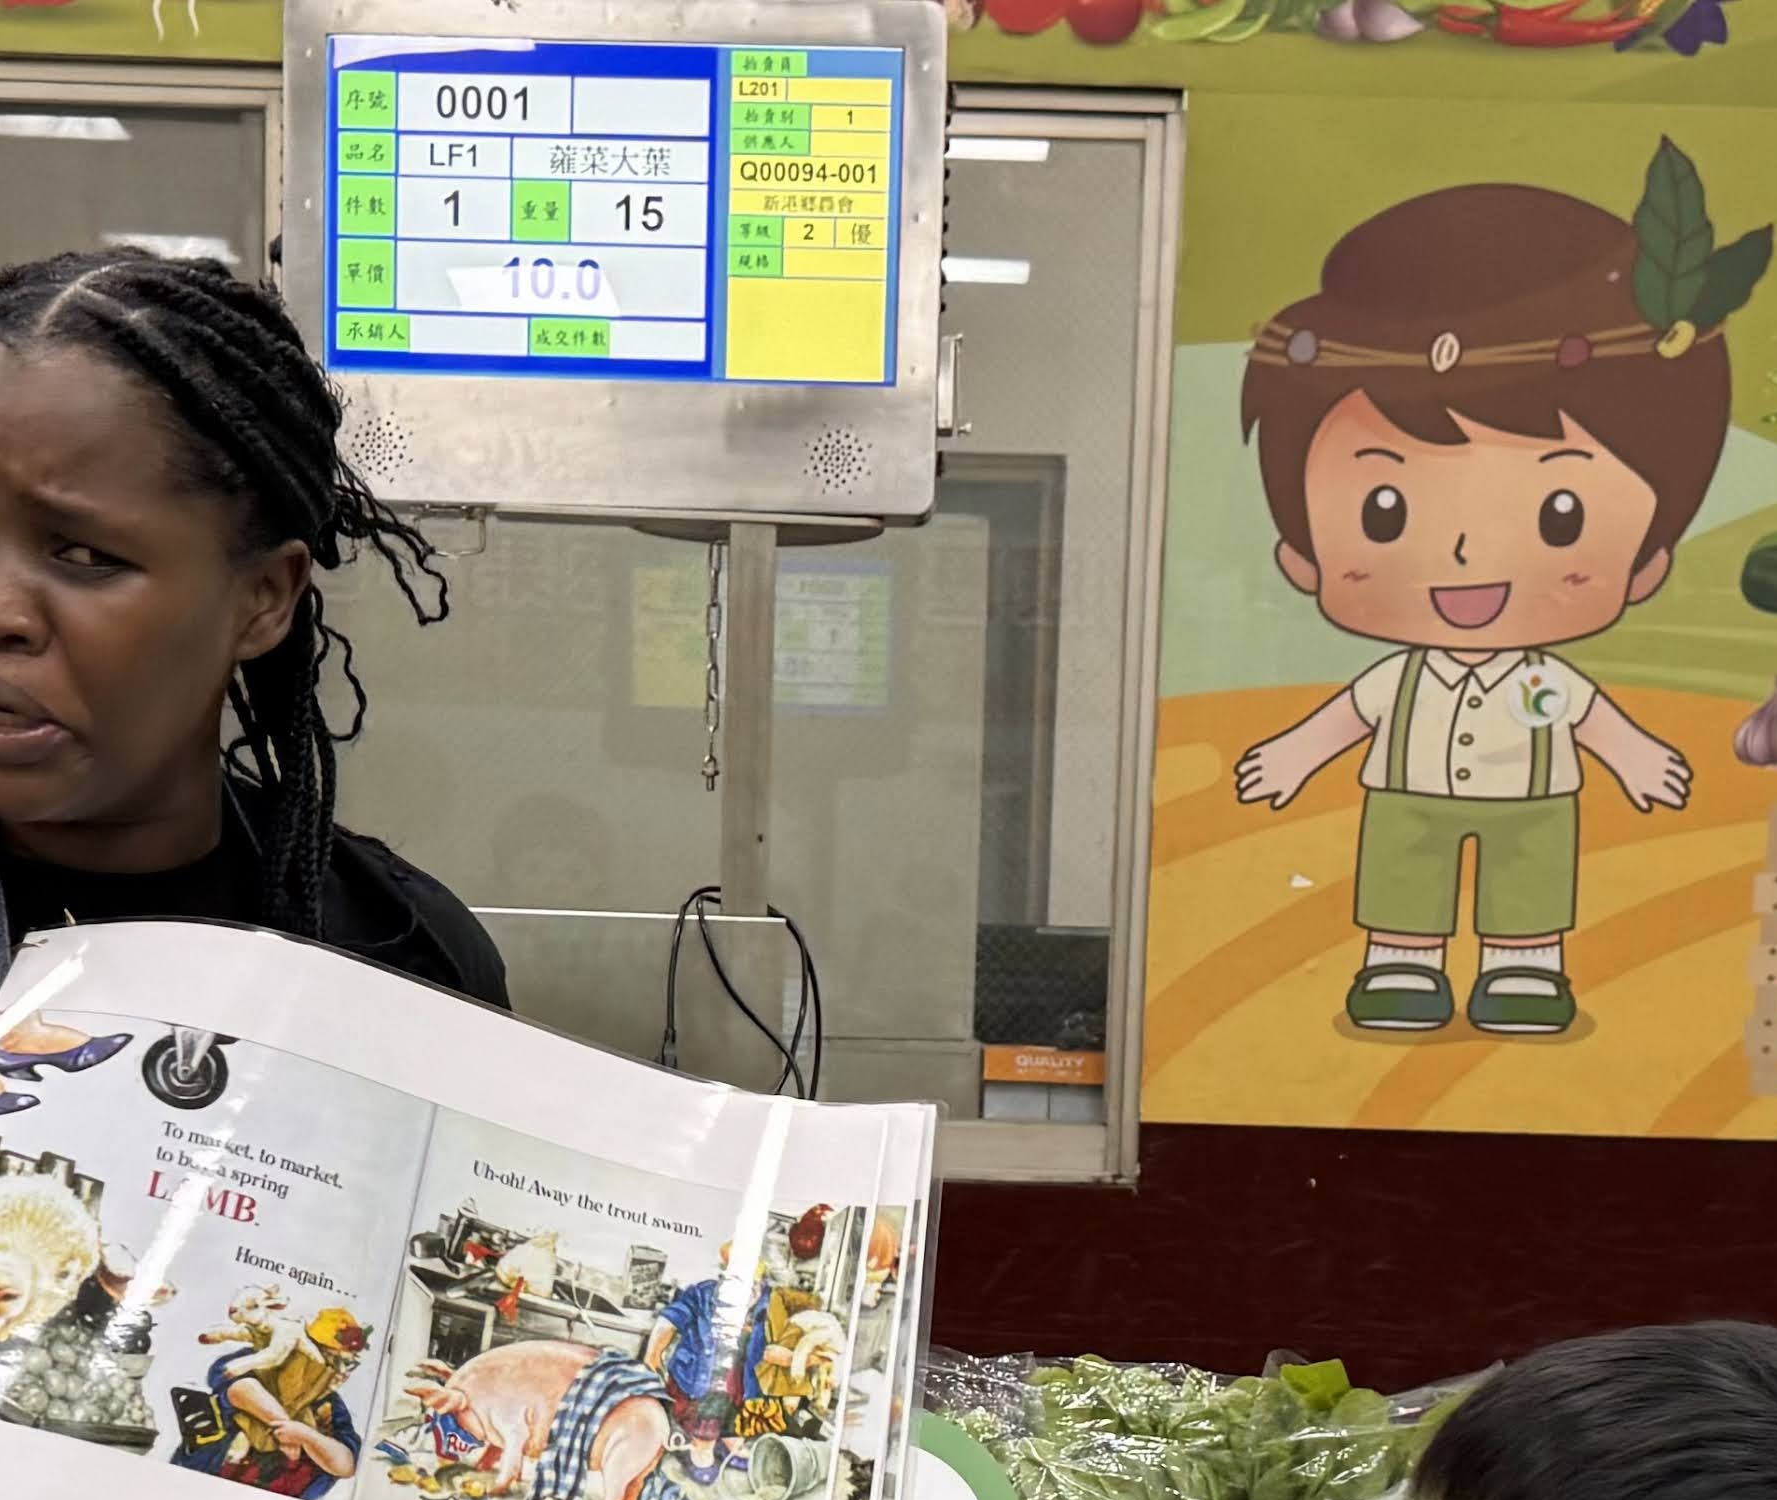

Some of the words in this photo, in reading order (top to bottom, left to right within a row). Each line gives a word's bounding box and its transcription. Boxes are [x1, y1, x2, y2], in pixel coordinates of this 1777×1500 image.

[345, 89, 388, 111] 序號
[739, 81, 777, 96] L201
[437, 85, 528, 121] 0001
[846, 110, 854, 125] 1
[345, 143, 385, 162] 品名
[430, 143, 477, 168] LF1
[740, 161, 876, 184] Q00094-001
[345, 195, 387, 216] 件數
[444, 190, 460, 227] 1
[521, 199, 560, 222] 重量
[615, 194, 664, 231] 15
[803, 224, 814, 240] 2
[343, 262, 385, 284] 單價
[502, 257, 601, 301] 10.0
[535, 329, 607, 347] 成交件數
[162, 1121, 184, 1140] To
[259, 1149, 276, 1165] to
[156, 1146, 173, 1162] to
[230, 1168, 289, 1199] spring
[147, 1170, 261, 1227] LMB.
[472, 1160, 525, 1191] Uh-oh!
[527, 1180, 574, 1206] Away
[577, 1194, 604, 1214] the
[607, 1203, 648, 1226] trout
[651, 1217, 703, 1238] swam.
[235, 1246, 285, 1274] Home
